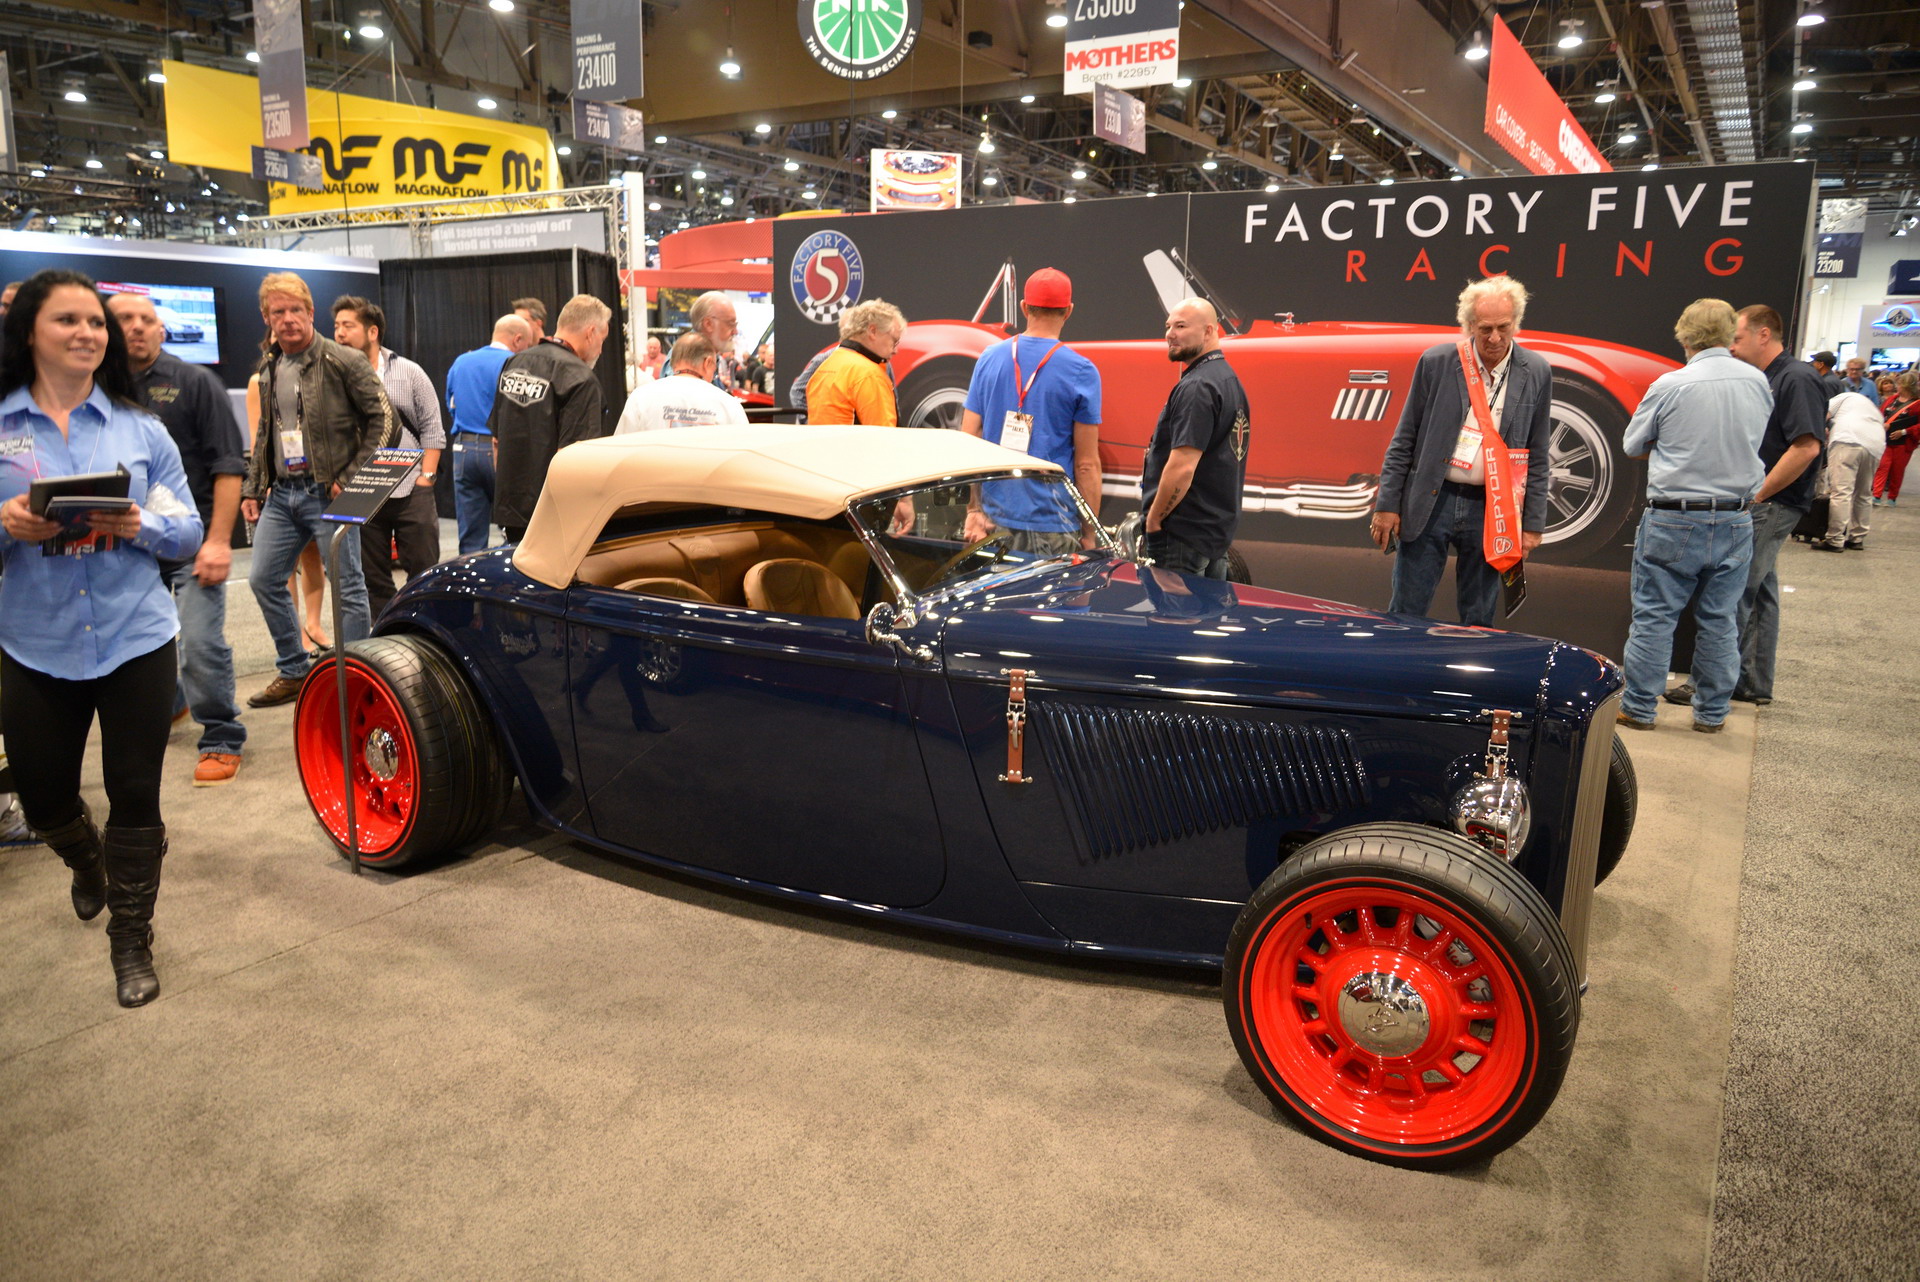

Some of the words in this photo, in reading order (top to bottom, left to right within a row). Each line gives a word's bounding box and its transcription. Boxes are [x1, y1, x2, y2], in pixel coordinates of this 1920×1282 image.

[576, 34, 597, 45] RACING
[576, 42, 616, 56] PERFORMANCE
[806, 35, 822, 58] THE
[820, 57, 863, 79] SENSOR
[867, 27, 916, 78] SPECIALIST
[1066, 39, 1176, 72] MOTHERS
[577, 53, 616, 90] 23400
[1082, 71, 1113, 83] Booth
[1117, 66, 1158, 79] #22957
[264, 110, 291, 139] 23500
[395, 184, 488, 197] MAGNAFLOW
[1244, 190, 1543, 244] FACTORY
[1588, 180, 1753, 230] FIVE
[794, 234, 842, 283] FACTORY
[842, 244, 860, 280] FIVE
[1345, 238, 1744, 283] RACING
[503, 378, 543, 399] SEMA
[1485, 447, 1507, 534] SPYDER
